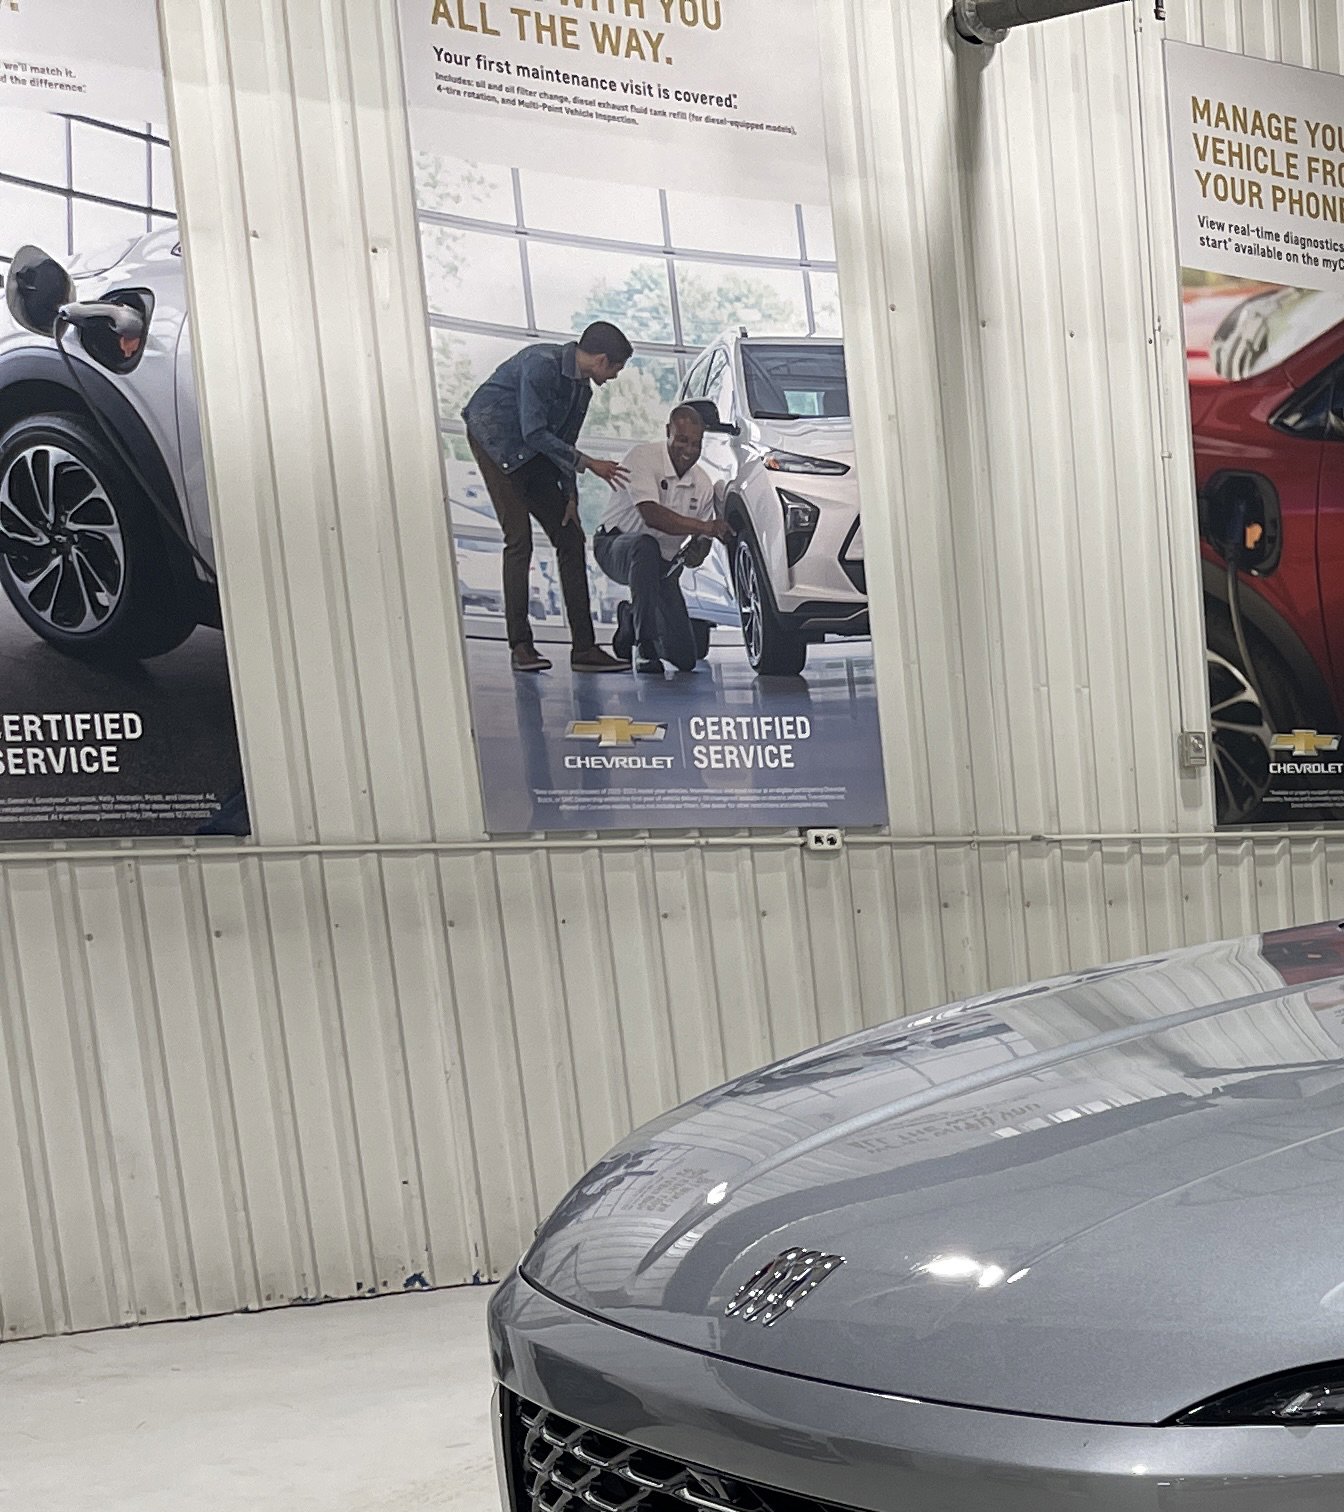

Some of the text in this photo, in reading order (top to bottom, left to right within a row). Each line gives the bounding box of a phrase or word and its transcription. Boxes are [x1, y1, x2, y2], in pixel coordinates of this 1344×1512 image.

[661, 0, 721, 30] YOU
[431, 0, 501, 36] ALL
[510, 8, 580, 50] THE
[590, 21, 673, 65] WAY.
[10, 75, 27, 86] the
[30, 65, 63, 77] match
[433, 45, 470, 67] Your
[475, 55, 512, 75] first
[516, 65, 617, 92] maintenance
[621, 79, 654, 98] visit
[657, 83, 670, 100] is
[1191, 96, 1298, 145] MANAGE
[1192, 133, 1300, 181] VEHICLE
[1194, 169, 1264, 210] YOUR
[1198, 214, 1226, 233] View
[1228, 222, 1281, 243] real-time
[1283, 231, 1344, 254] diagnostics
[1234, 241, 1283, 261] available
[1285, 251, 1299, 264] on
[1301, 253, 1320, 267] the
[0, 712, 144, 742] ERTIFIED
[690, 716, 811, 741] CERTIFIED
[564, 756, 675, 769] CHEVROLET
[693, 745, 795, 769] SERVICE
[1268, 762, 1344, 774] CHEVROLET
